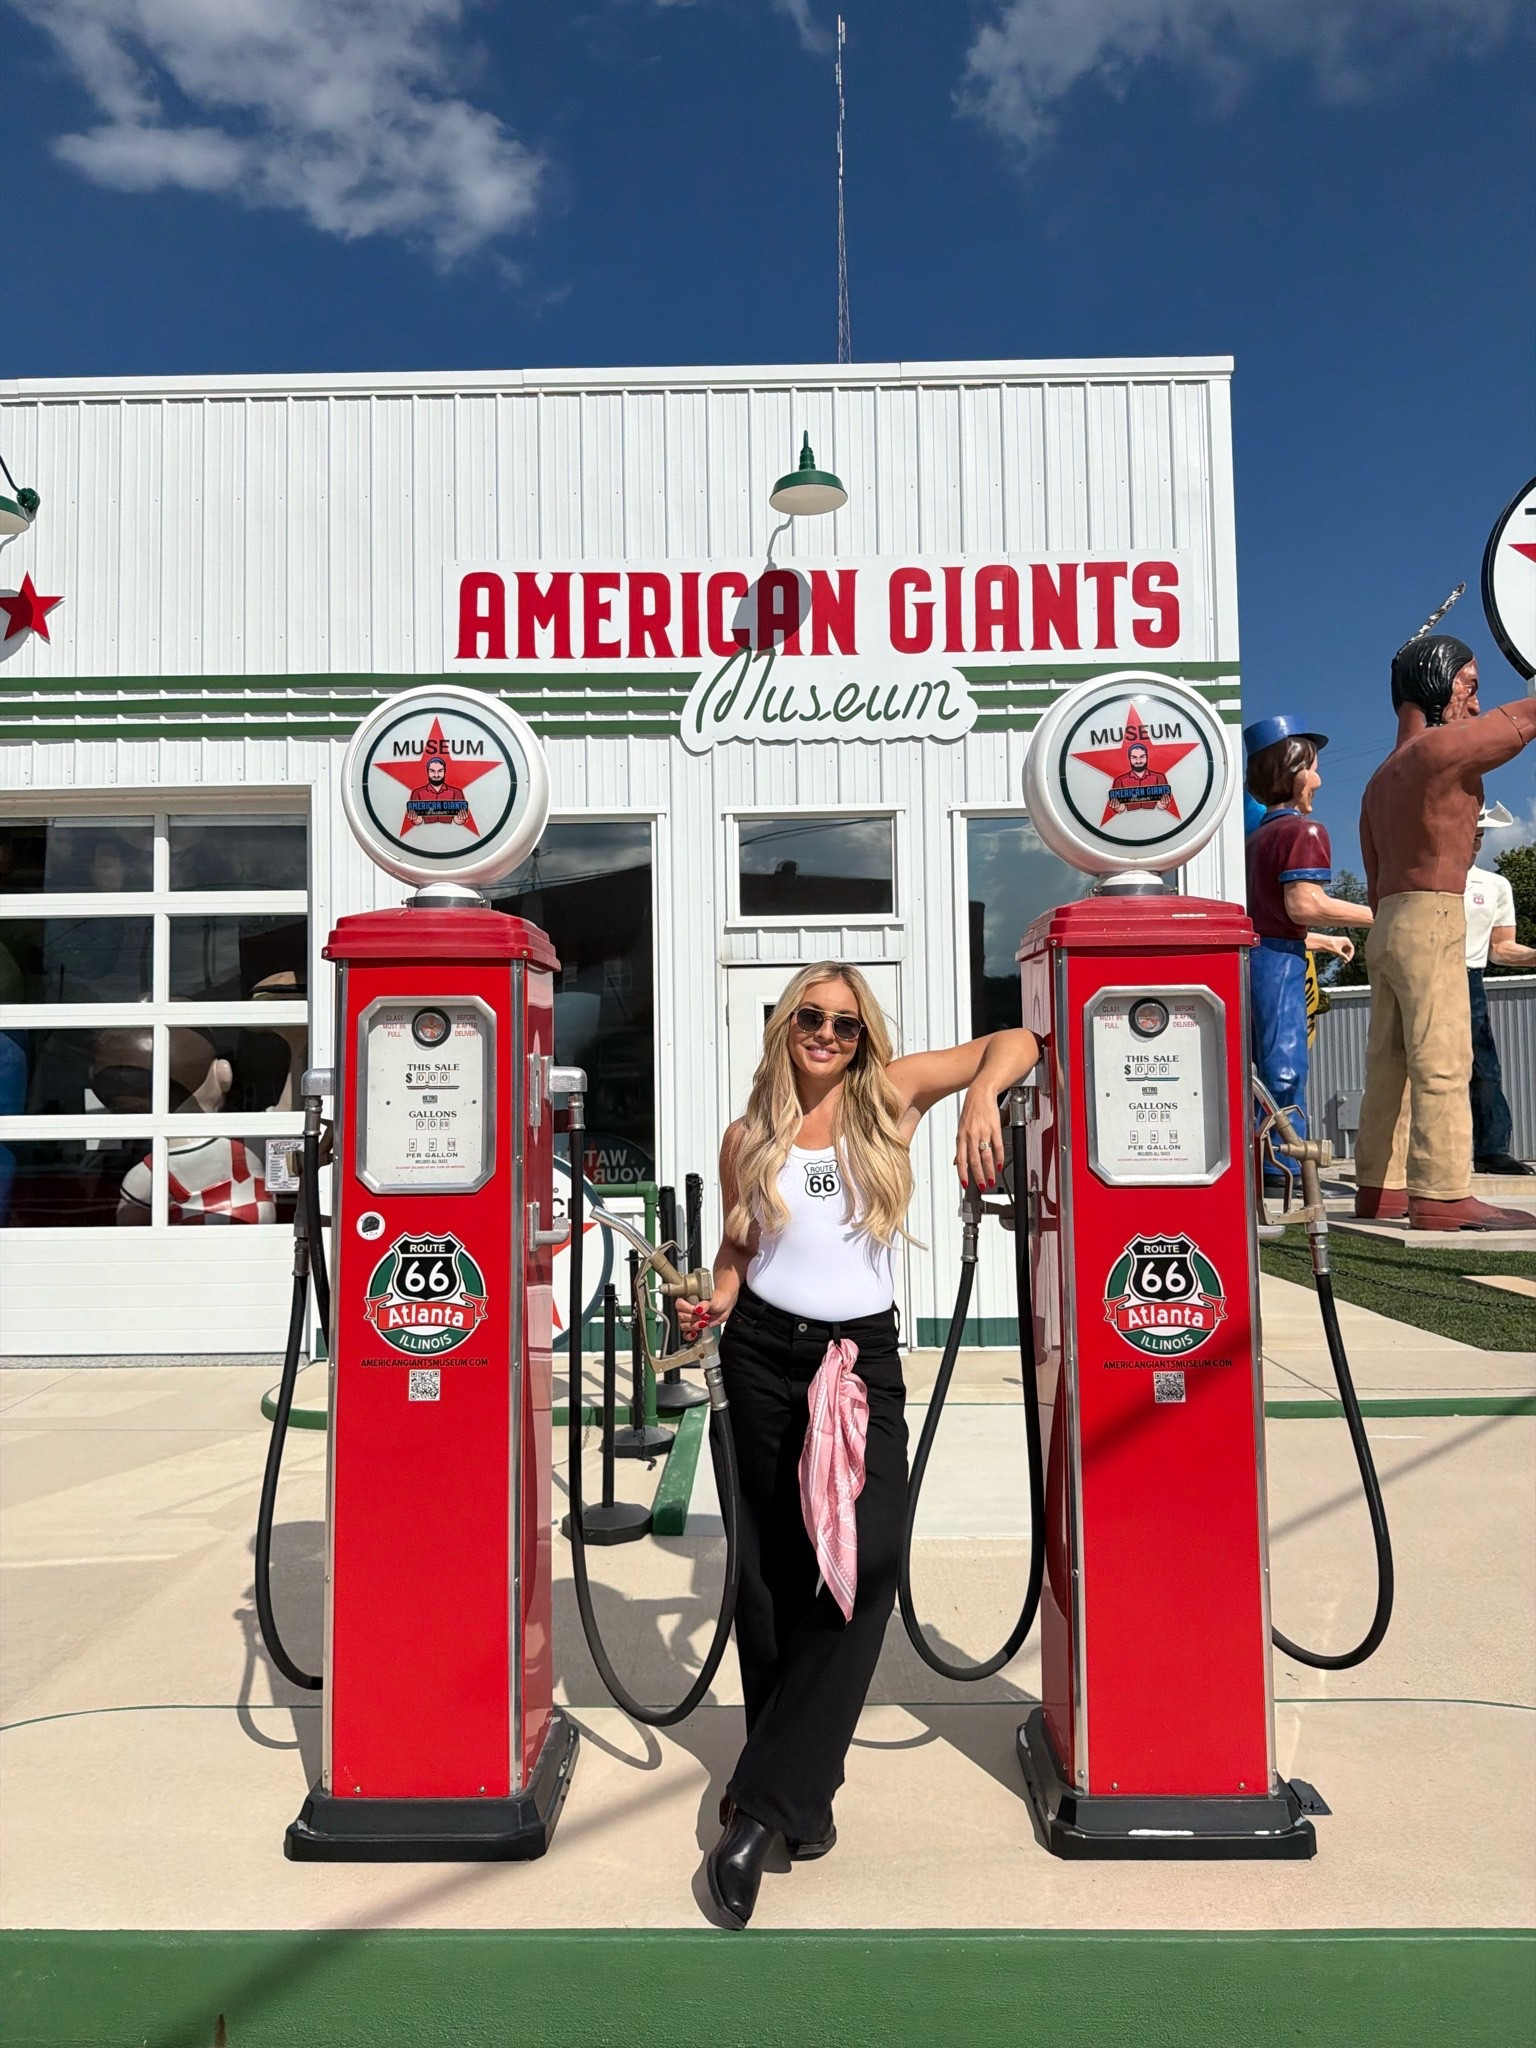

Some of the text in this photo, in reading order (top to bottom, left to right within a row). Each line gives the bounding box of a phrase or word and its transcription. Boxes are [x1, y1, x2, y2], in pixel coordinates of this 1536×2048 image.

[453, 561, 1181, 659] AMERICAN GIANTS
[696, 647, 960, 733] Museum
[1090, 723, 1182, 745] MUSEUM
[393, 740, 484, 756] MUSEUM
[1110, 787, 1145, 799] AMERICAN
[1146, 785, 1171, 795] GIANTS
[408, 801, 468, 811] AMERICAN GIANTS
[1125, 1055, 1179, 1063] THIS SALE
[407, 1063, 460, 1071] THIS SALE
[1124, 1064, 1131, 1075] $
[405, 1072, 413, 1084] $
[1128, 1102, 1178, 1110] GALLONS
[408, 1110, 457, 1118] GALLONS
[810, 1164, 834, 1173] ROUTE
[809, 1174, 835, 1193] 66
[409, 1244, 446, 1253] ROUTE
[1143, 1244, 1180, 1254] ROUTE
[405, 1260, 449, 1293] 66
[1141, 1261, 1186, 1293] 66
[388, 1303, 464, 1328] Atlanta
[1128, 1304, 1204, 1328] Atlanta
[399, 1333, 452, 1350] ILLINOIS
[1140, 1334, 1193, 1350] ILLINOIS
